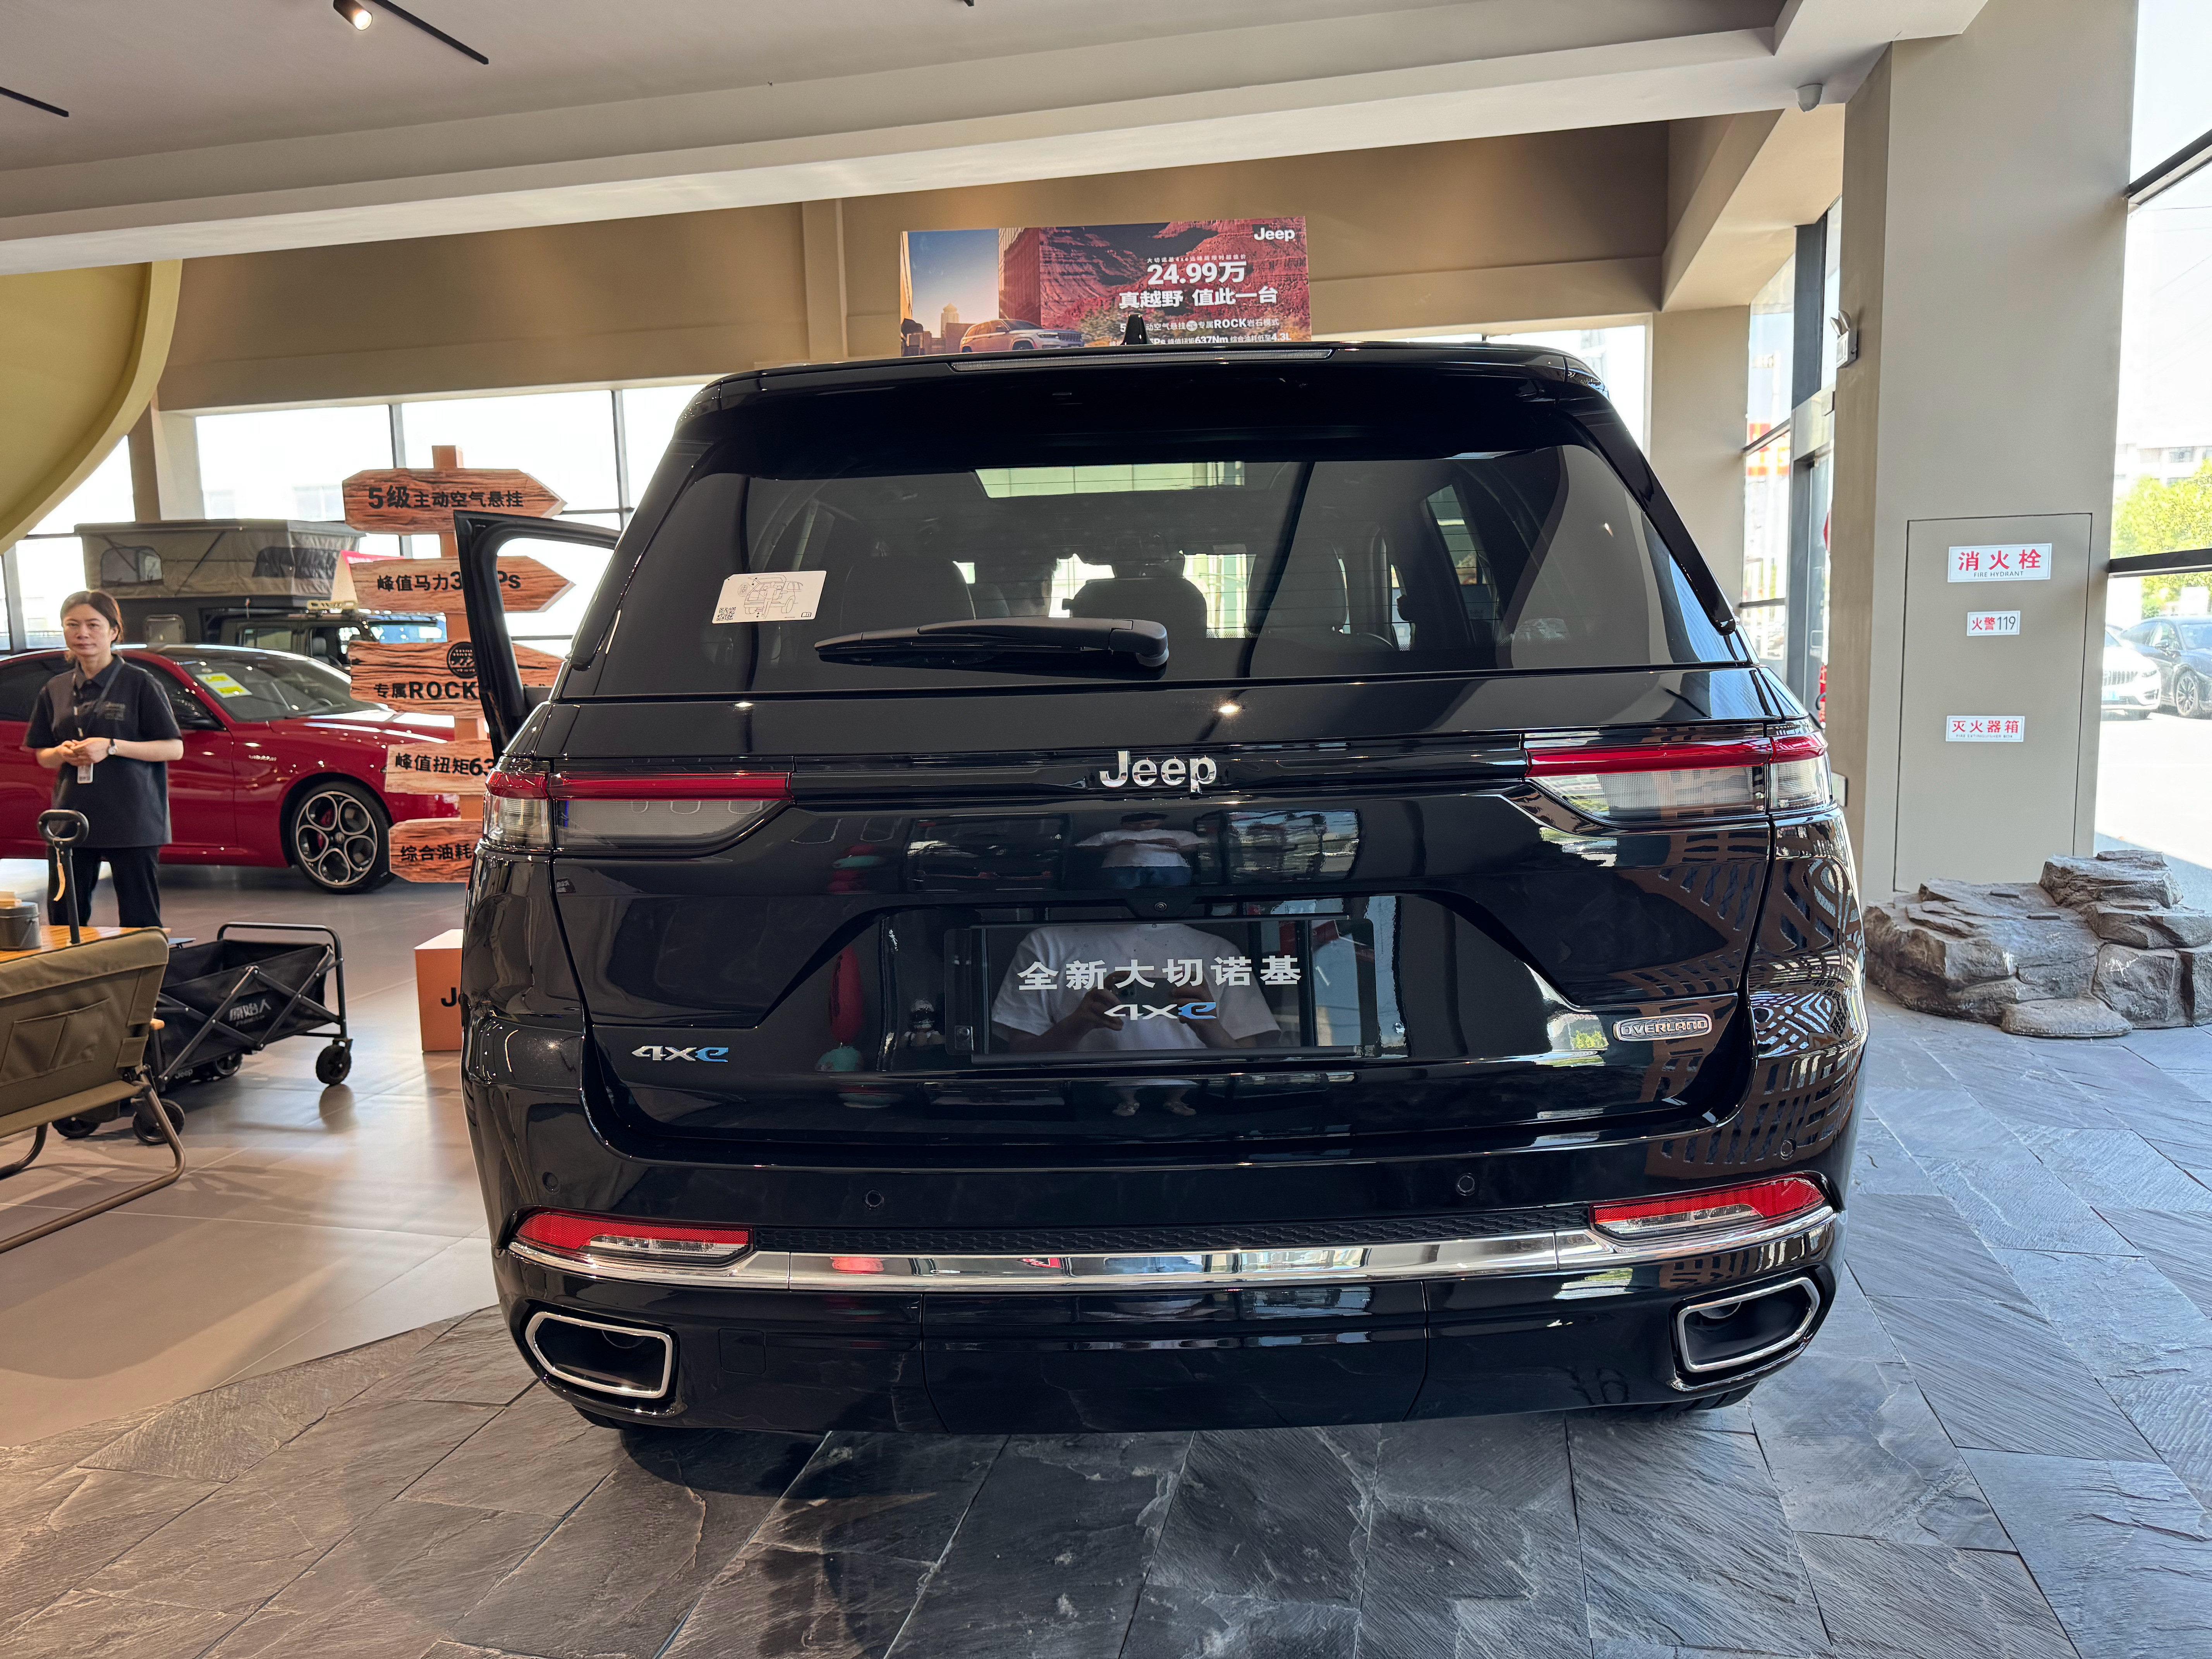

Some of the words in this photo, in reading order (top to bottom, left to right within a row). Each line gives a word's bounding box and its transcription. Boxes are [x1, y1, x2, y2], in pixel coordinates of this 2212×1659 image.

[1254, 227, 1295, 242] Jeep
[1147, 261, 1247, 285] 24.99万
[1119, 290, 1184, 309] 真越野
[1192, 285, 1278, 306] 值此一台
[1198, 318, 1279, 329] 专属ROCK岩石模式
[368, 485, 524, 509] 5级主动空气悬挂
[1958, 549, 2041, 571] 消火栓
[377, 570, 521, 592] 峰值马力3Ps
[1952, 720, 2019, 733] 灭火器箱
[1099, 750, 1217, 794] Jeep
[400, 843, 472, 862] 综合油耗
[1017, 955, 1302, 991] 全新大切诺基
[441, 987, 460, 1007] J
[1621, 1020, 1708, 1035] OVERLAND
